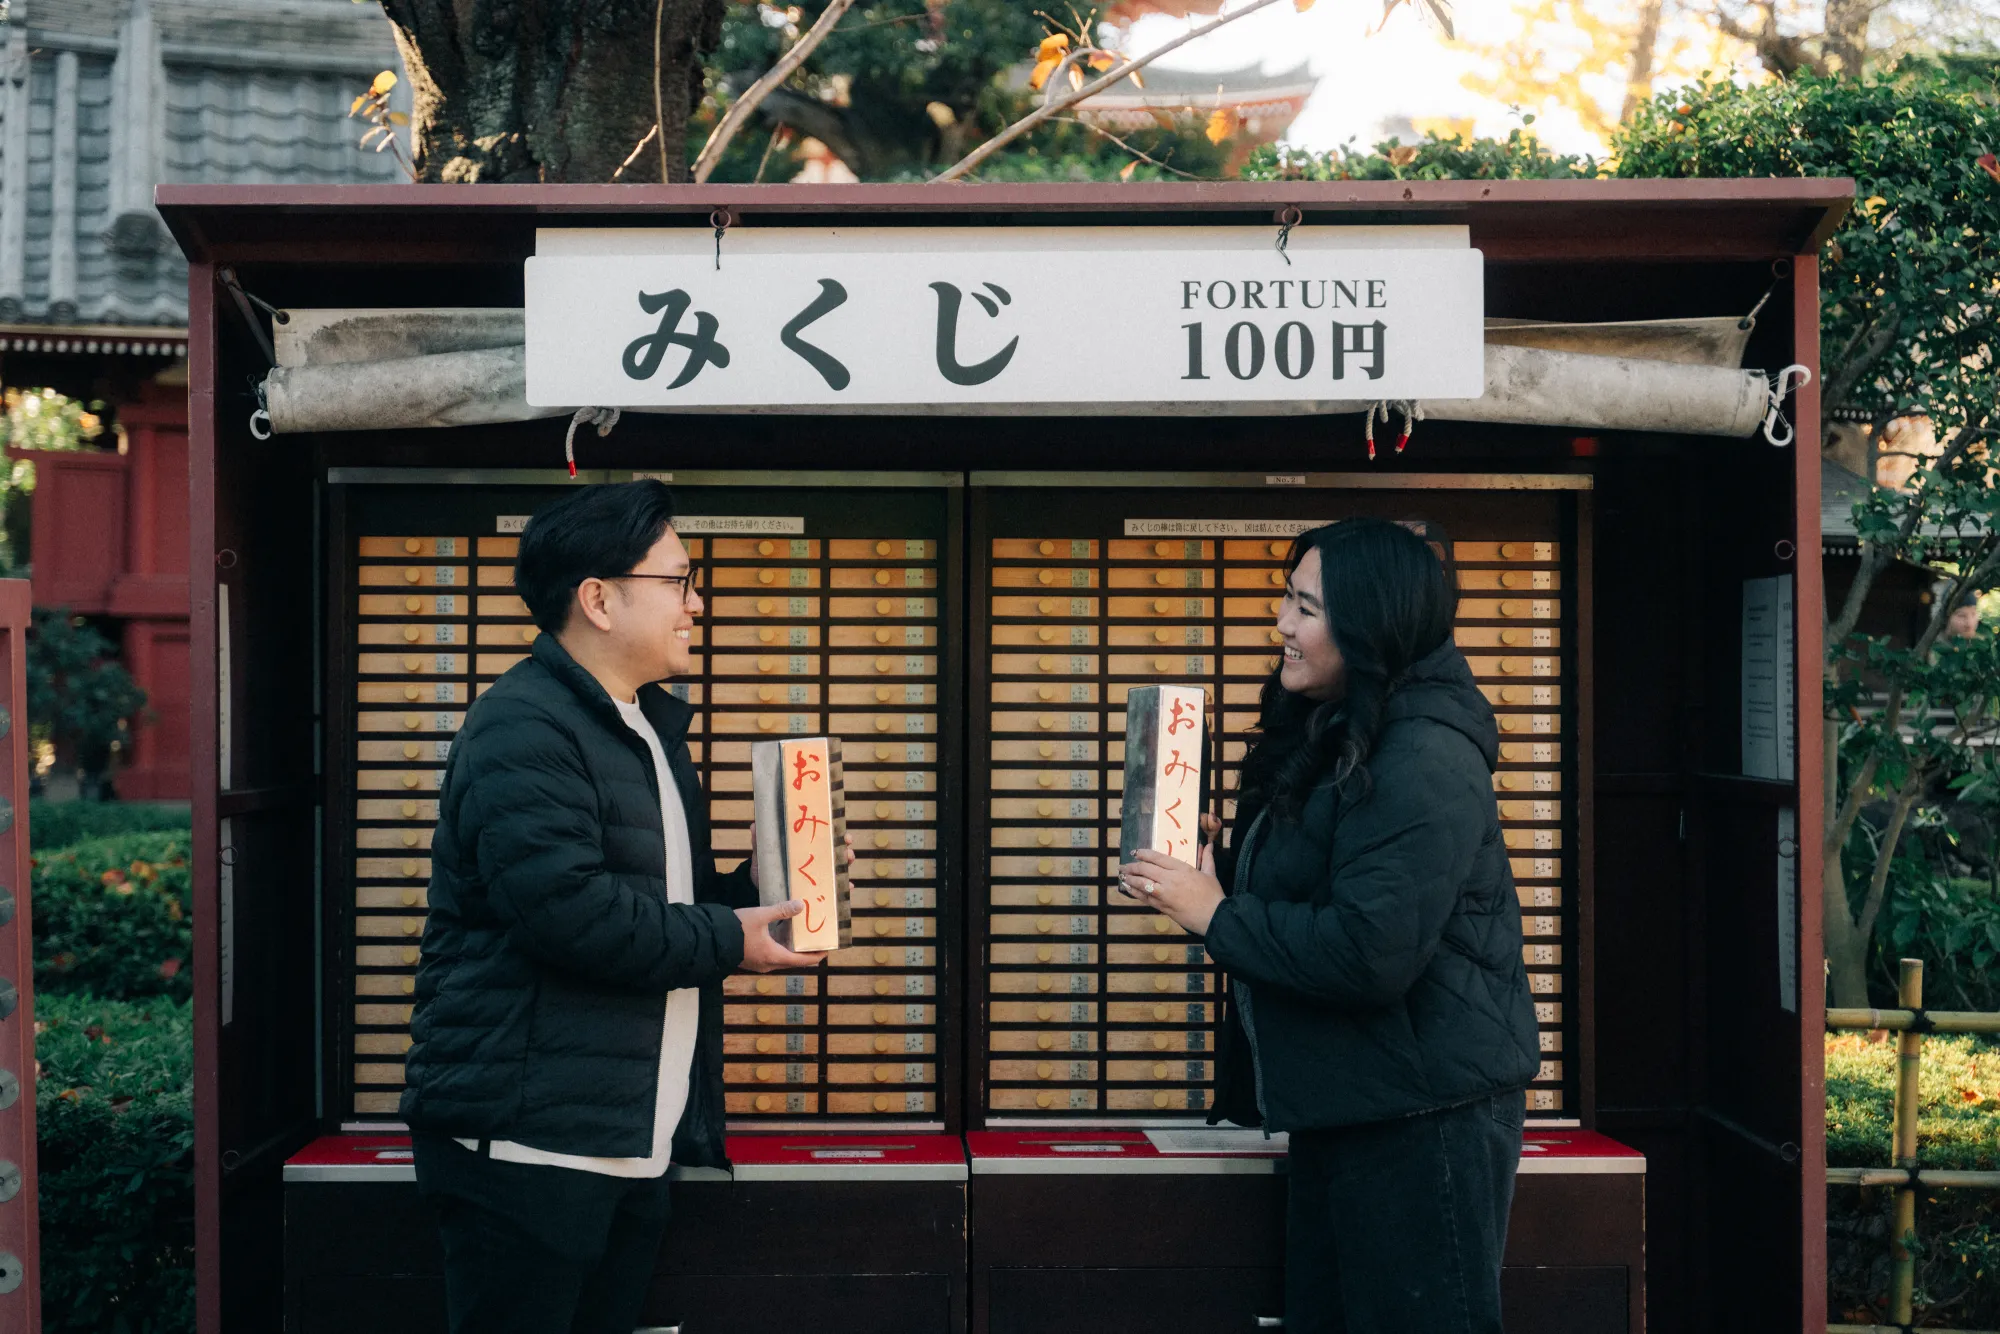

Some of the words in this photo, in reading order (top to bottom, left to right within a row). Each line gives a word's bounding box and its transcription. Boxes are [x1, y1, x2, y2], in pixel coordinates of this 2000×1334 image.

[622, 279, 1019, 391] みくじ
[1182, 280, 1387, 309] FORTUNE
[1181, 320, 1387, 380] 100円
[793, 751, 829, 933] おみくじ
